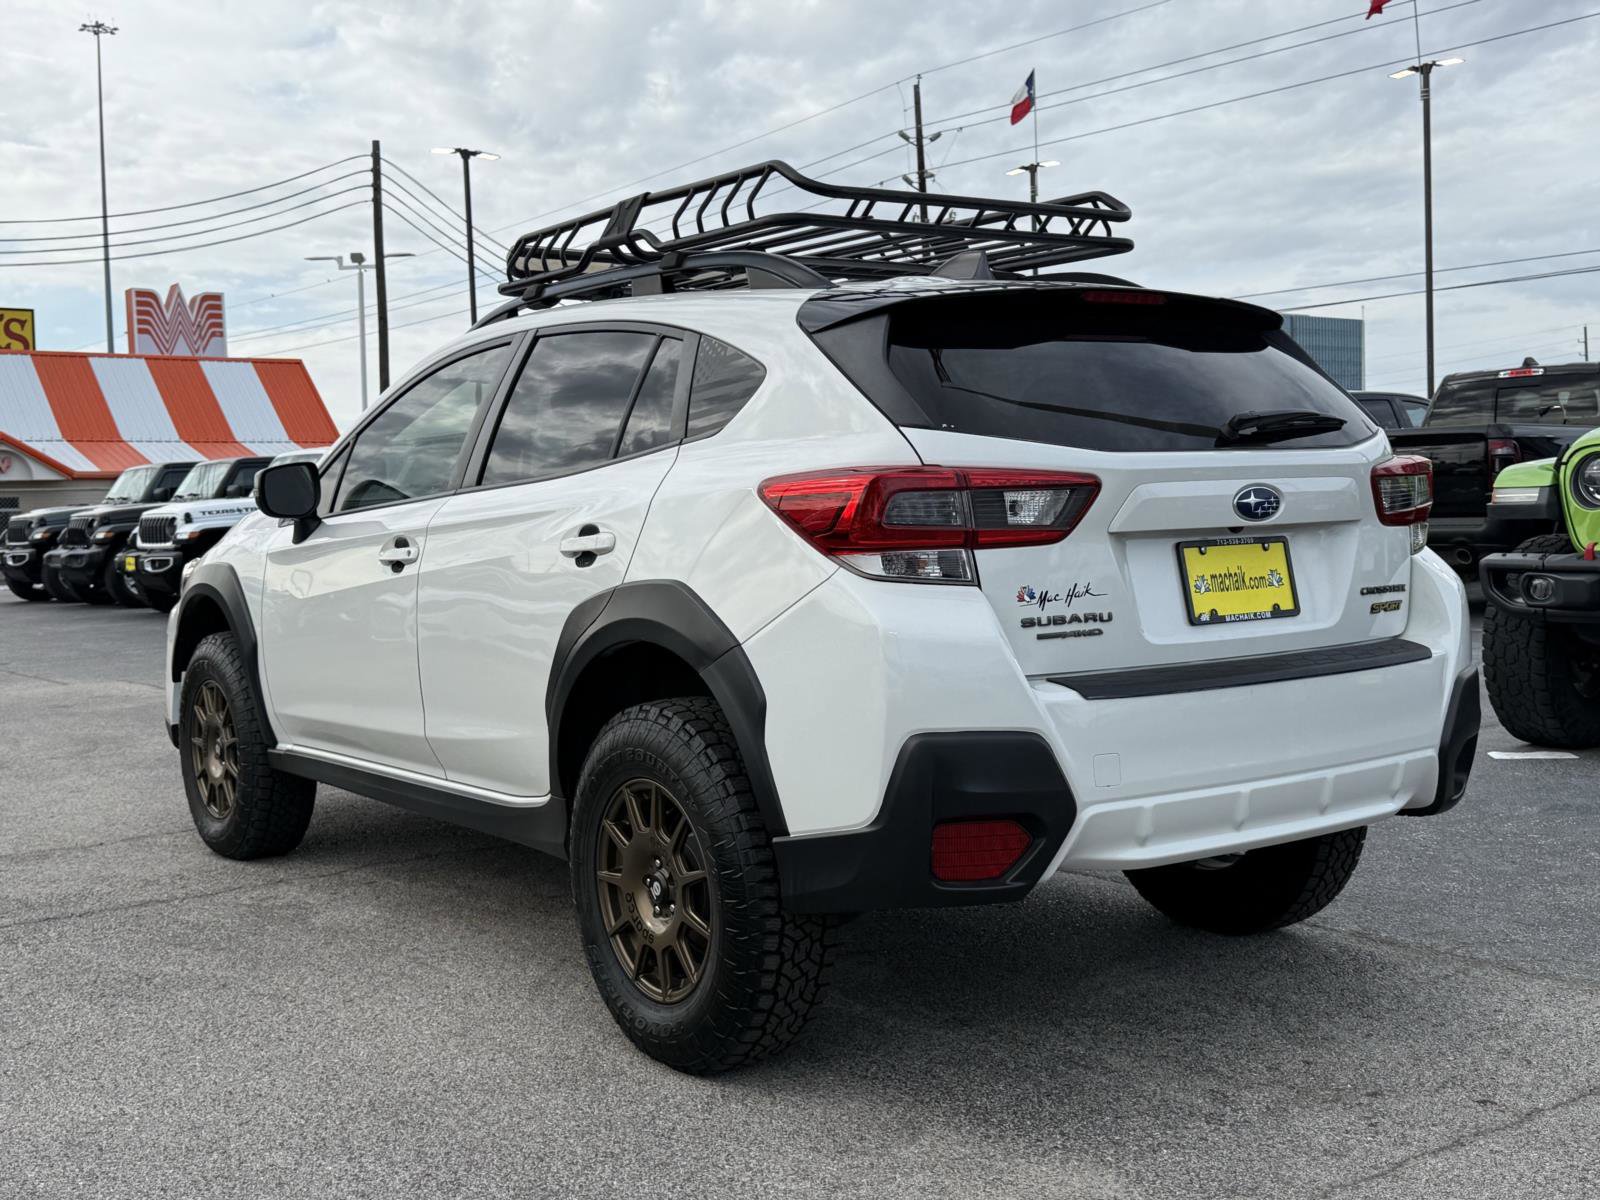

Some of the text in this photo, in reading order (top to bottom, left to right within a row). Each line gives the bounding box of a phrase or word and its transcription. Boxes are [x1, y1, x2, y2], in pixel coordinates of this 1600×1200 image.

[1209, 565, 1268, 592] machaik.com
[1030, 582, 1108, 611] Mac Haik
[1020, 612, 1113, 628] SUBARU
[1225, 611, 1271, 622] MACHAIK.COM
[625, 892, 655, 944] sparco
